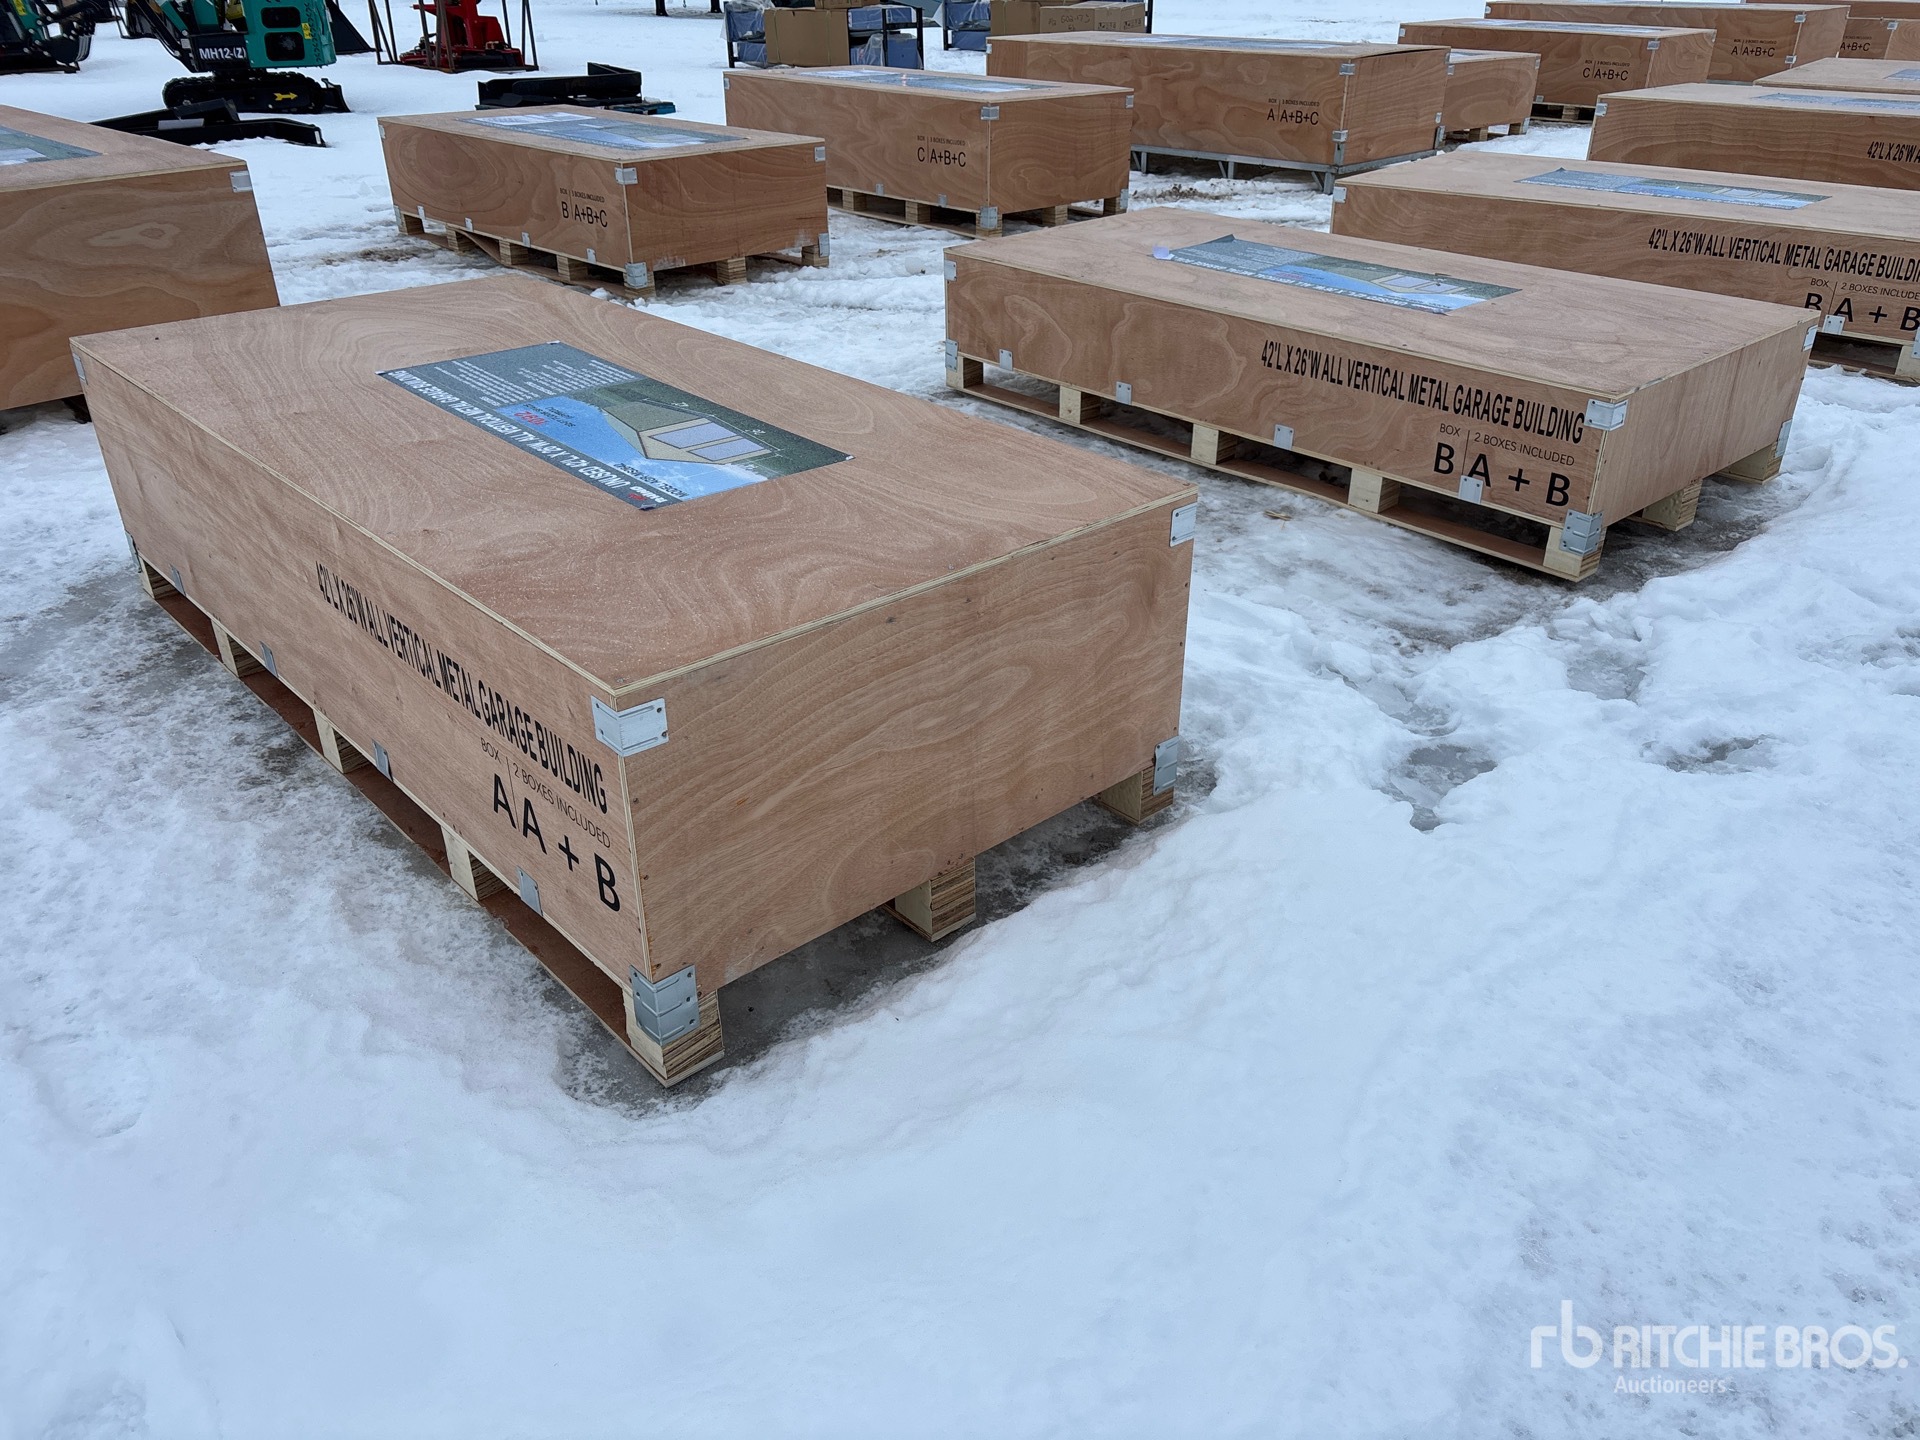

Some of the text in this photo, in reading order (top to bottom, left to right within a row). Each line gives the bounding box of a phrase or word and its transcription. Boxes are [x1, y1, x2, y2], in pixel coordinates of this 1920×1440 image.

[1731, 46, 1776, 57] A A+B+C
[1840, 42, 1870, 51] A+B+C
[1582, 68, 1628, 81] C A+B+C
[1266, 108, 1319, 126] A A+B+C
[917, 146, 966, 168] C A+B+C
[1884, 142, 1895, 160] X
[562, 200, 608, 228] B A+B+C
[1648, 228, 1668, 250] 42'L
[1670, 230, 1680, 252] X
[1678, 232, 1706, 254] 26'W
[1704, 234, 1725, 258] ALL
[1728, 236, 1782, 264] VERTICAL
[1783, 244, 1821, 270] METAL
[1824, 248, 1877, 276] GARAGE
[1810, 278, 1830, 288] BOX
[1840, 282, 1847, 290] 2
[1848, 284, 1878, 294] BOXES
[1833, 298, 1854, 322] A
[1868, 306, 1888, 324] +
[1900, 306, 1920, 331] B
[387, 370, 432, 389] BUILDING
[418, 385, 460, 404] GARAGE
[1261, 340, 1585, 444] 42'L X 26'W ALL VERTICAL METAL GARAGE BUILDING
[448, 400, 484, 416] METAL
[472, 412, 522, 435] VERTICAL
[510, 431, 540, 442] ALL
[1440, 423, 1574, 466] BOX 2 BOXES INCLUDED
[546, 450, 570, 458] X
[578, 466, 631, 489] UNUSED
[1434, 442, 1571, 507] B A + B
[332, 573, 346, 616] X
[364, 596, 388, 648] ALL
[382, 610, 442, 689] VERTICAL
[436, 649, 481, 720] METAL
[478, 680, 538, 762] GARAGE
[534, 720, 608, 814] BUILDING
[480, 737, 611, 849] BOX 2 BOXES INCLUDED
[494, 773, 620, 912] A A + B
